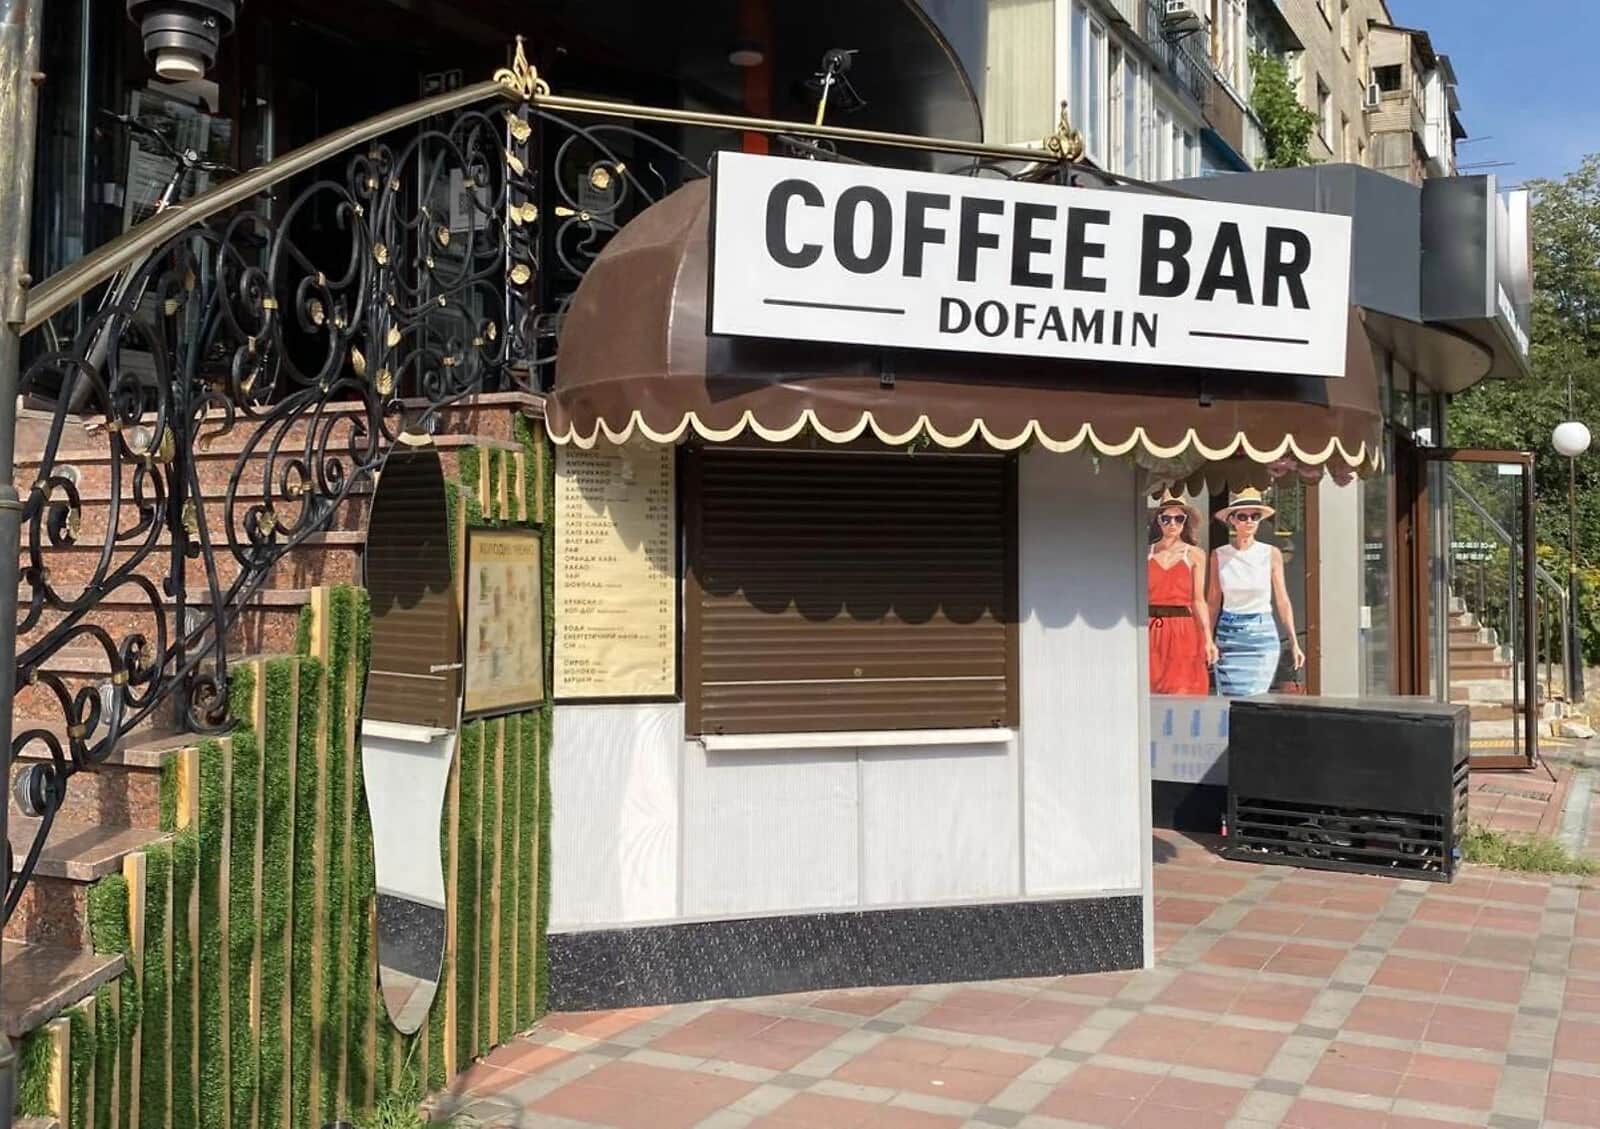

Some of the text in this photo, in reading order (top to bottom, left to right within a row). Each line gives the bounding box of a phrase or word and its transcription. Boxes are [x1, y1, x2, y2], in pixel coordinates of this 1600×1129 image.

[766, 179, 1313, 309] COFFEE BAR
[939, 297, 1159, 348] DOFAMIN
